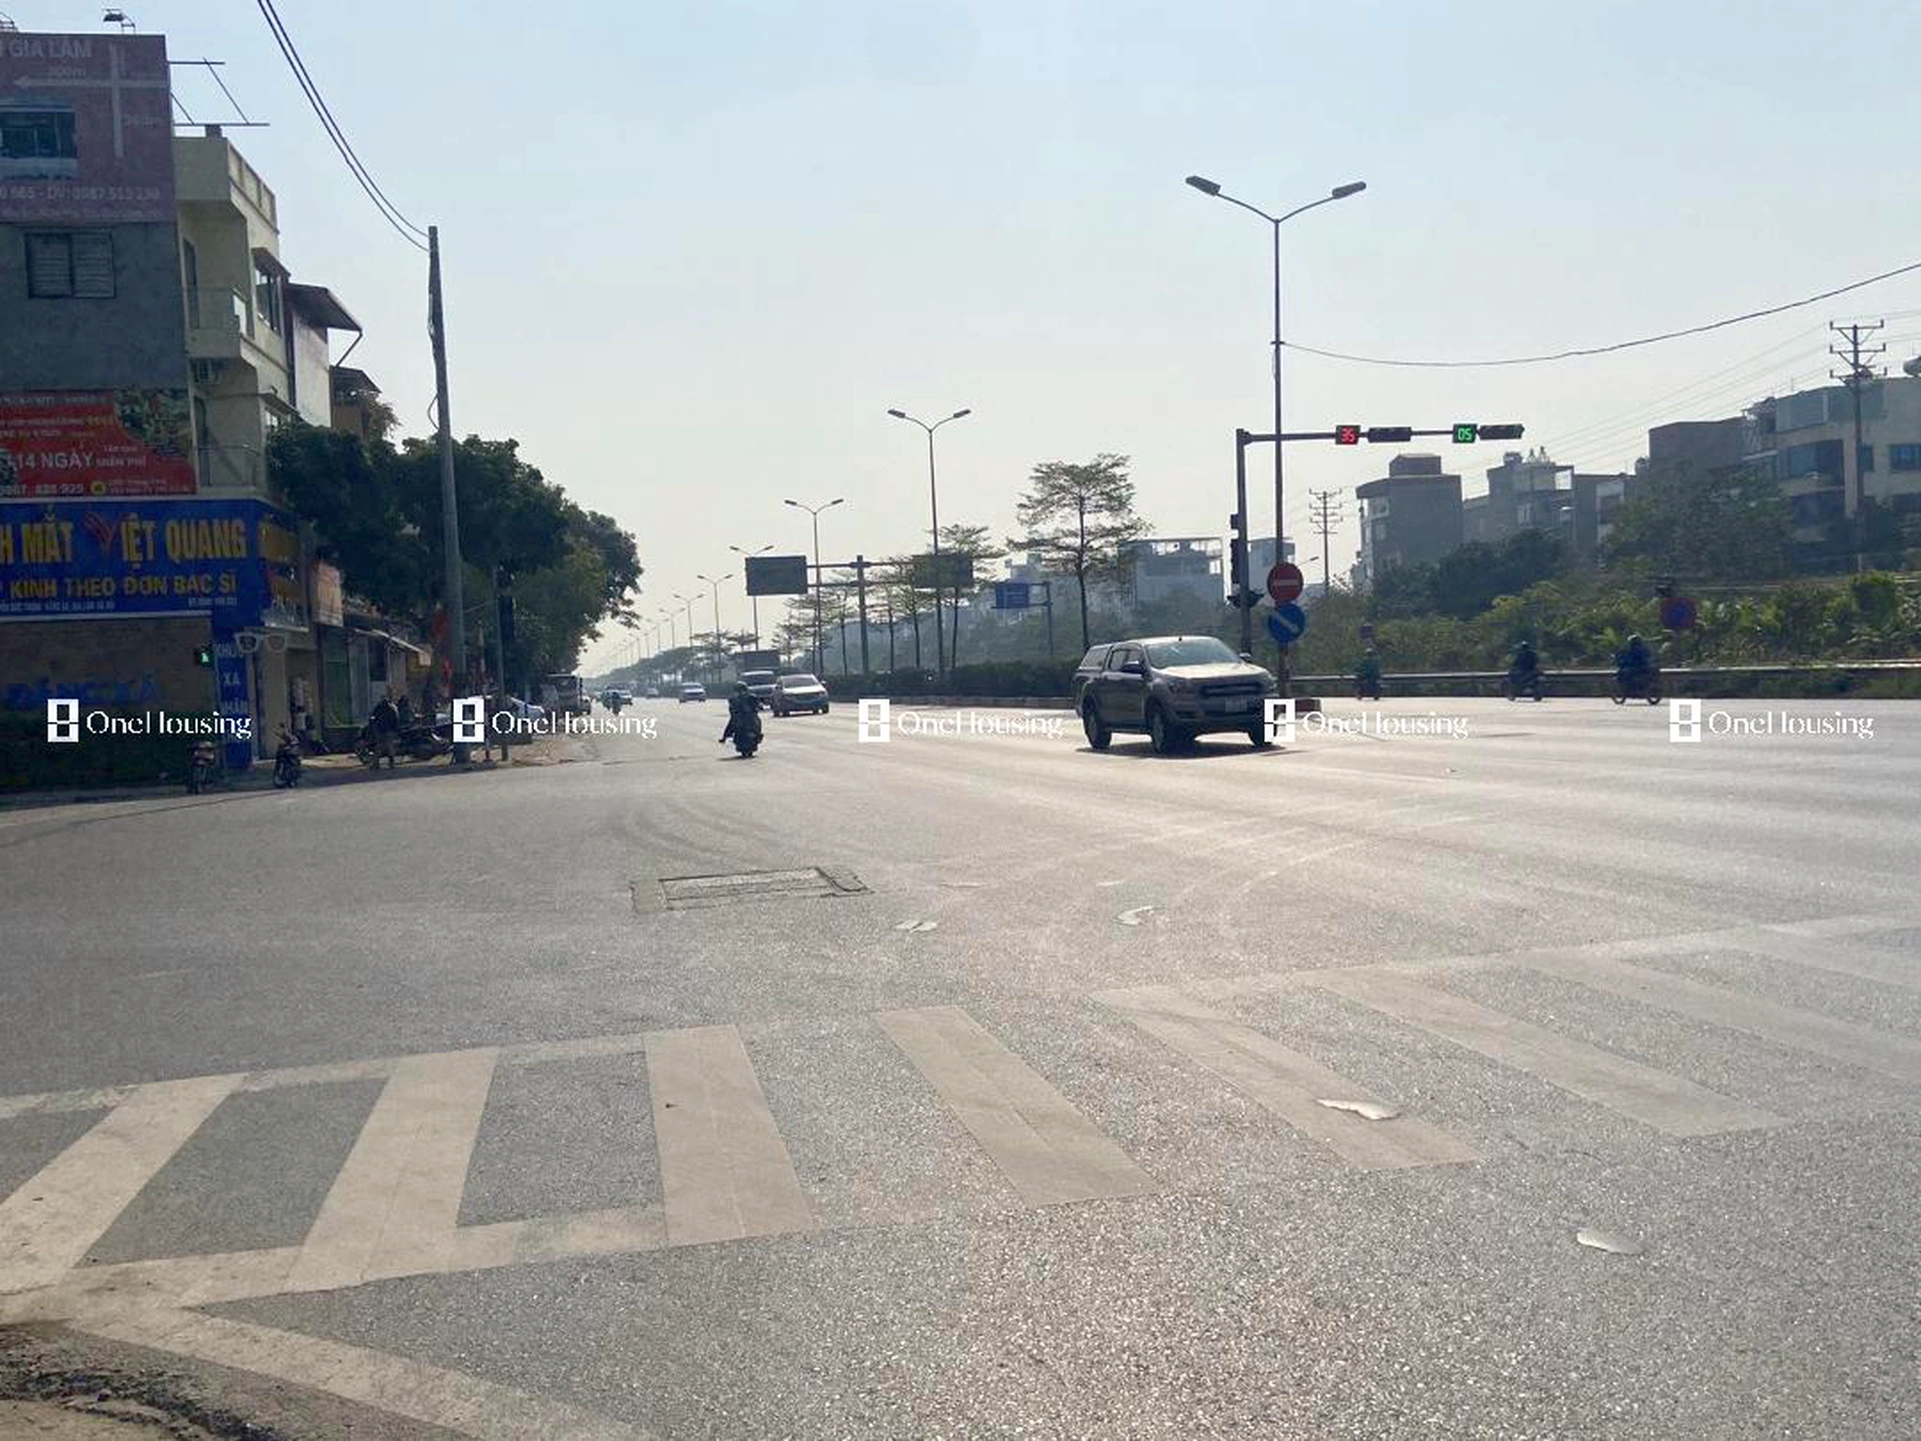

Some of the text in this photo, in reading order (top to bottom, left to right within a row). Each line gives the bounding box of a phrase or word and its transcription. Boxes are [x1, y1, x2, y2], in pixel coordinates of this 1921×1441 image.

[1457, 428, 1472, 441] 05
[166, 519, 248, 565] QUANG
[65, 575, 117, 597] THEO
